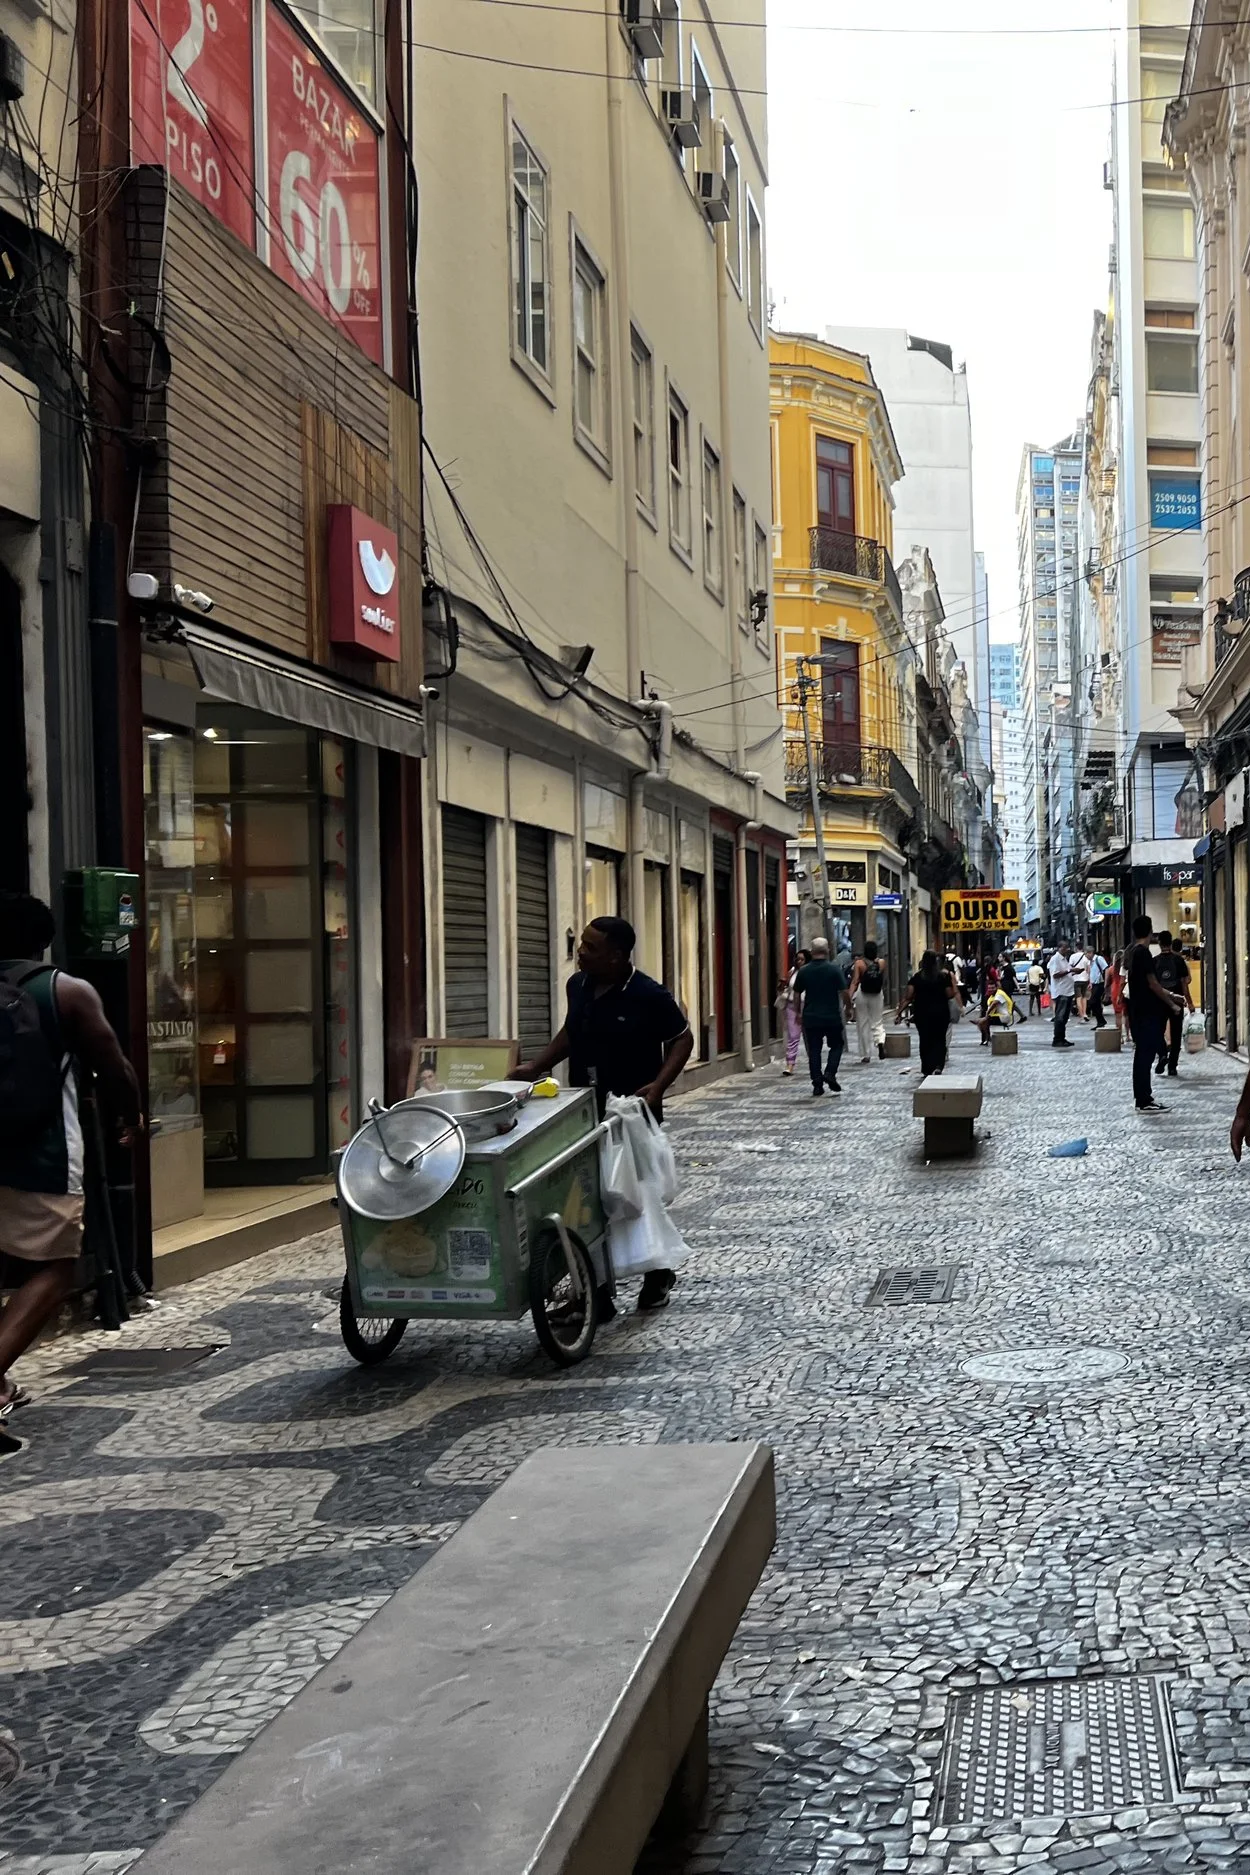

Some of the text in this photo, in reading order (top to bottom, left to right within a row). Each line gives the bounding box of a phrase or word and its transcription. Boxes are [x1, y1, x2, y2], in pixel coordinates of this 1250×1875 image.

[291, 54, 357, 164] BAZAR
[165, 116, 221, 200] PISO
[354, 289, 371, 313] OFF
[1154, 492, 1197, 504] 2509.9050
[1155, 504, 1197, 515] 2532.2053
[836, 888, 856, 901] D&K
[944, 899, 1018, 921] OURO
